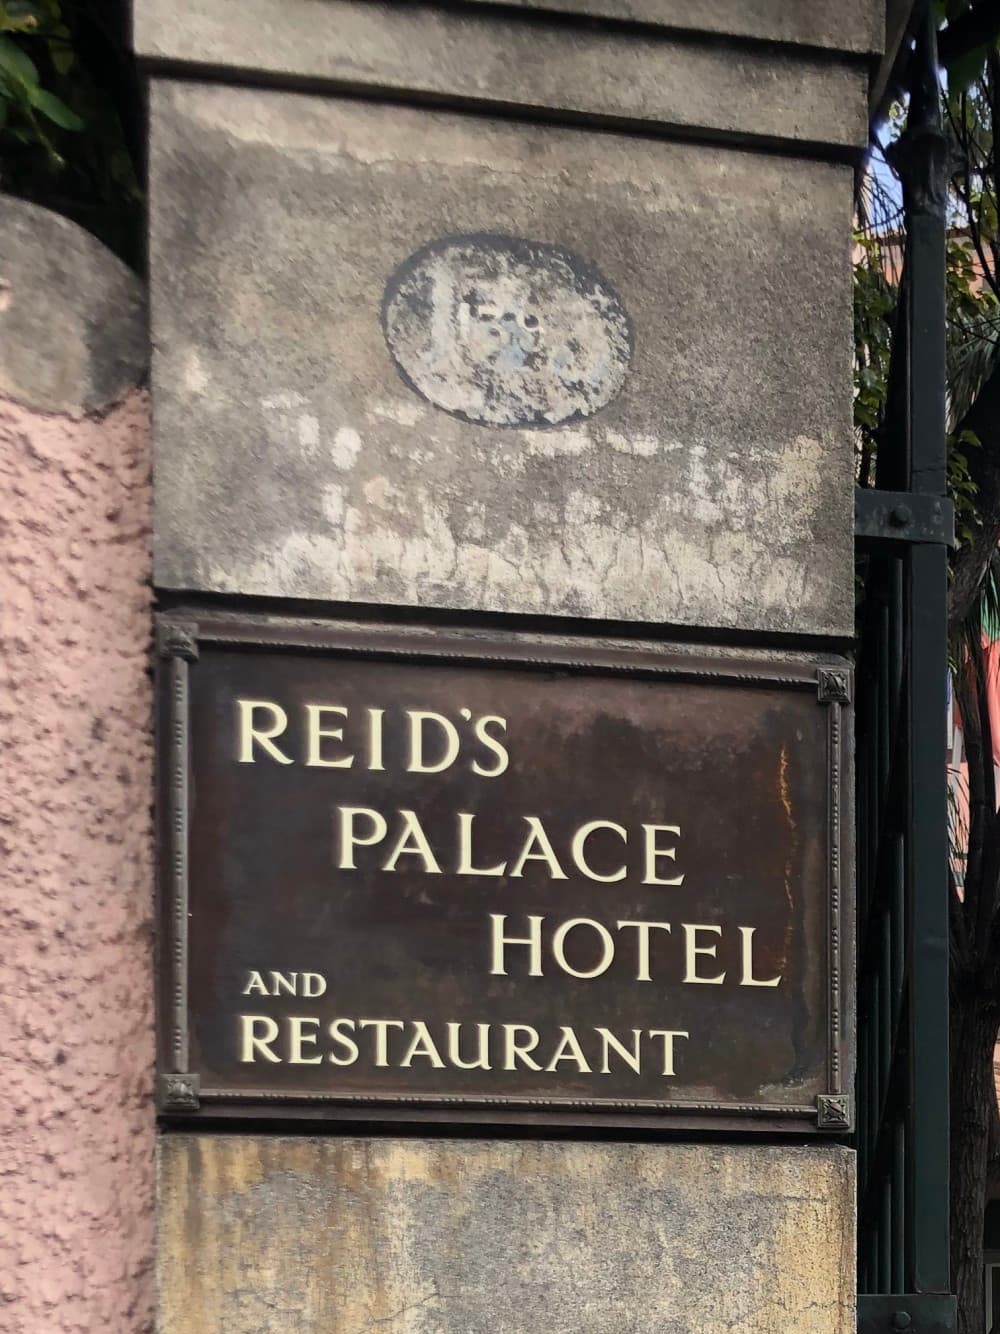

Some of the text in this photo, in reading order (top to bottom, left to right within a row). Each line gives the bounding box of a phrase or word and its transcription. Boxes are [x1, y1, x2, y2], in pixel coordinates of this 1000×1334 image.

[236, 699, 510, 778] REID'S
[337, 806, 686, 886] PALACE
[242, 970, 327, 999] AND
[489, 913, 783, 988] HOTEL
[240, 1015, 690, 1076] RESTAURANT
